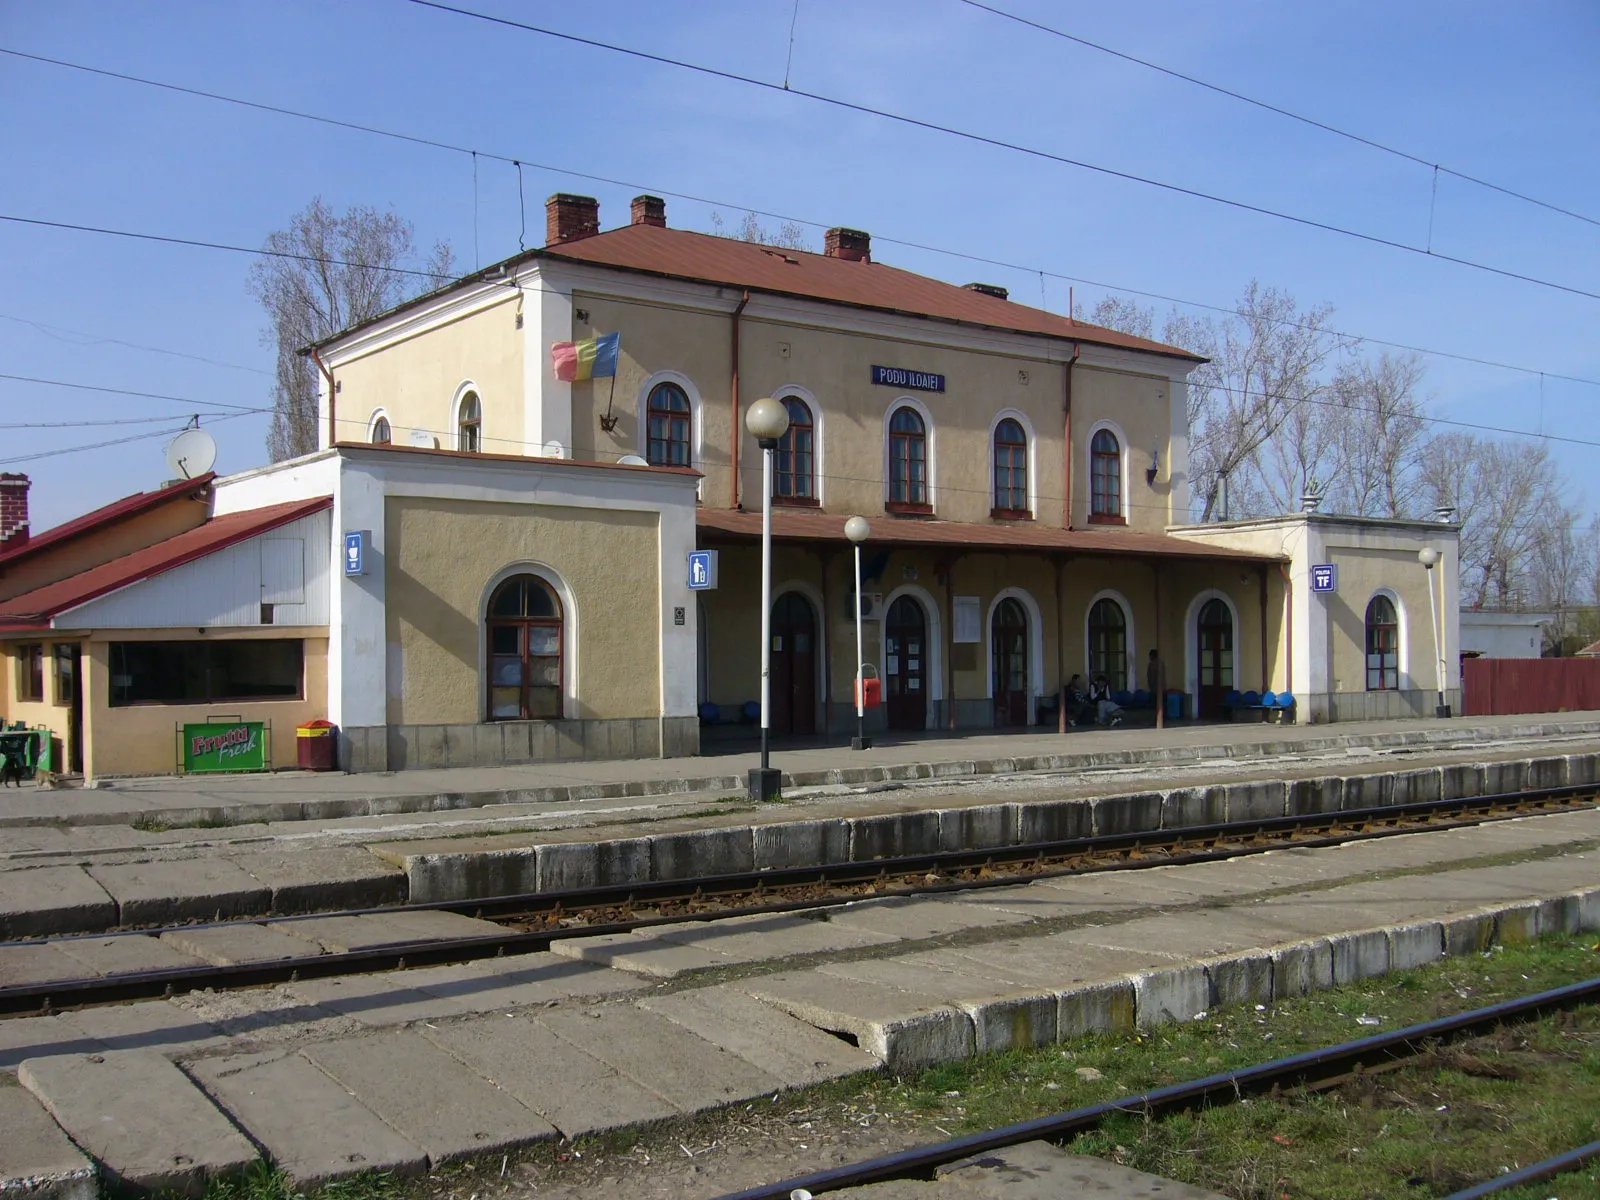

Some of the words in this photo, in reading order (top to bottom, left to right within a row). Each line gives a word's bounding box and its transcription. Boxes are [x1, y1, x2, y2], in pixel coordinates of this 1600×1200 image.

[880, 368, 906, 385] PODU
[909, 373, 938, 390] ILOAIEI
[1316, 576, 1330, 587] TF
[192, 726, 249, 756] Frutti
